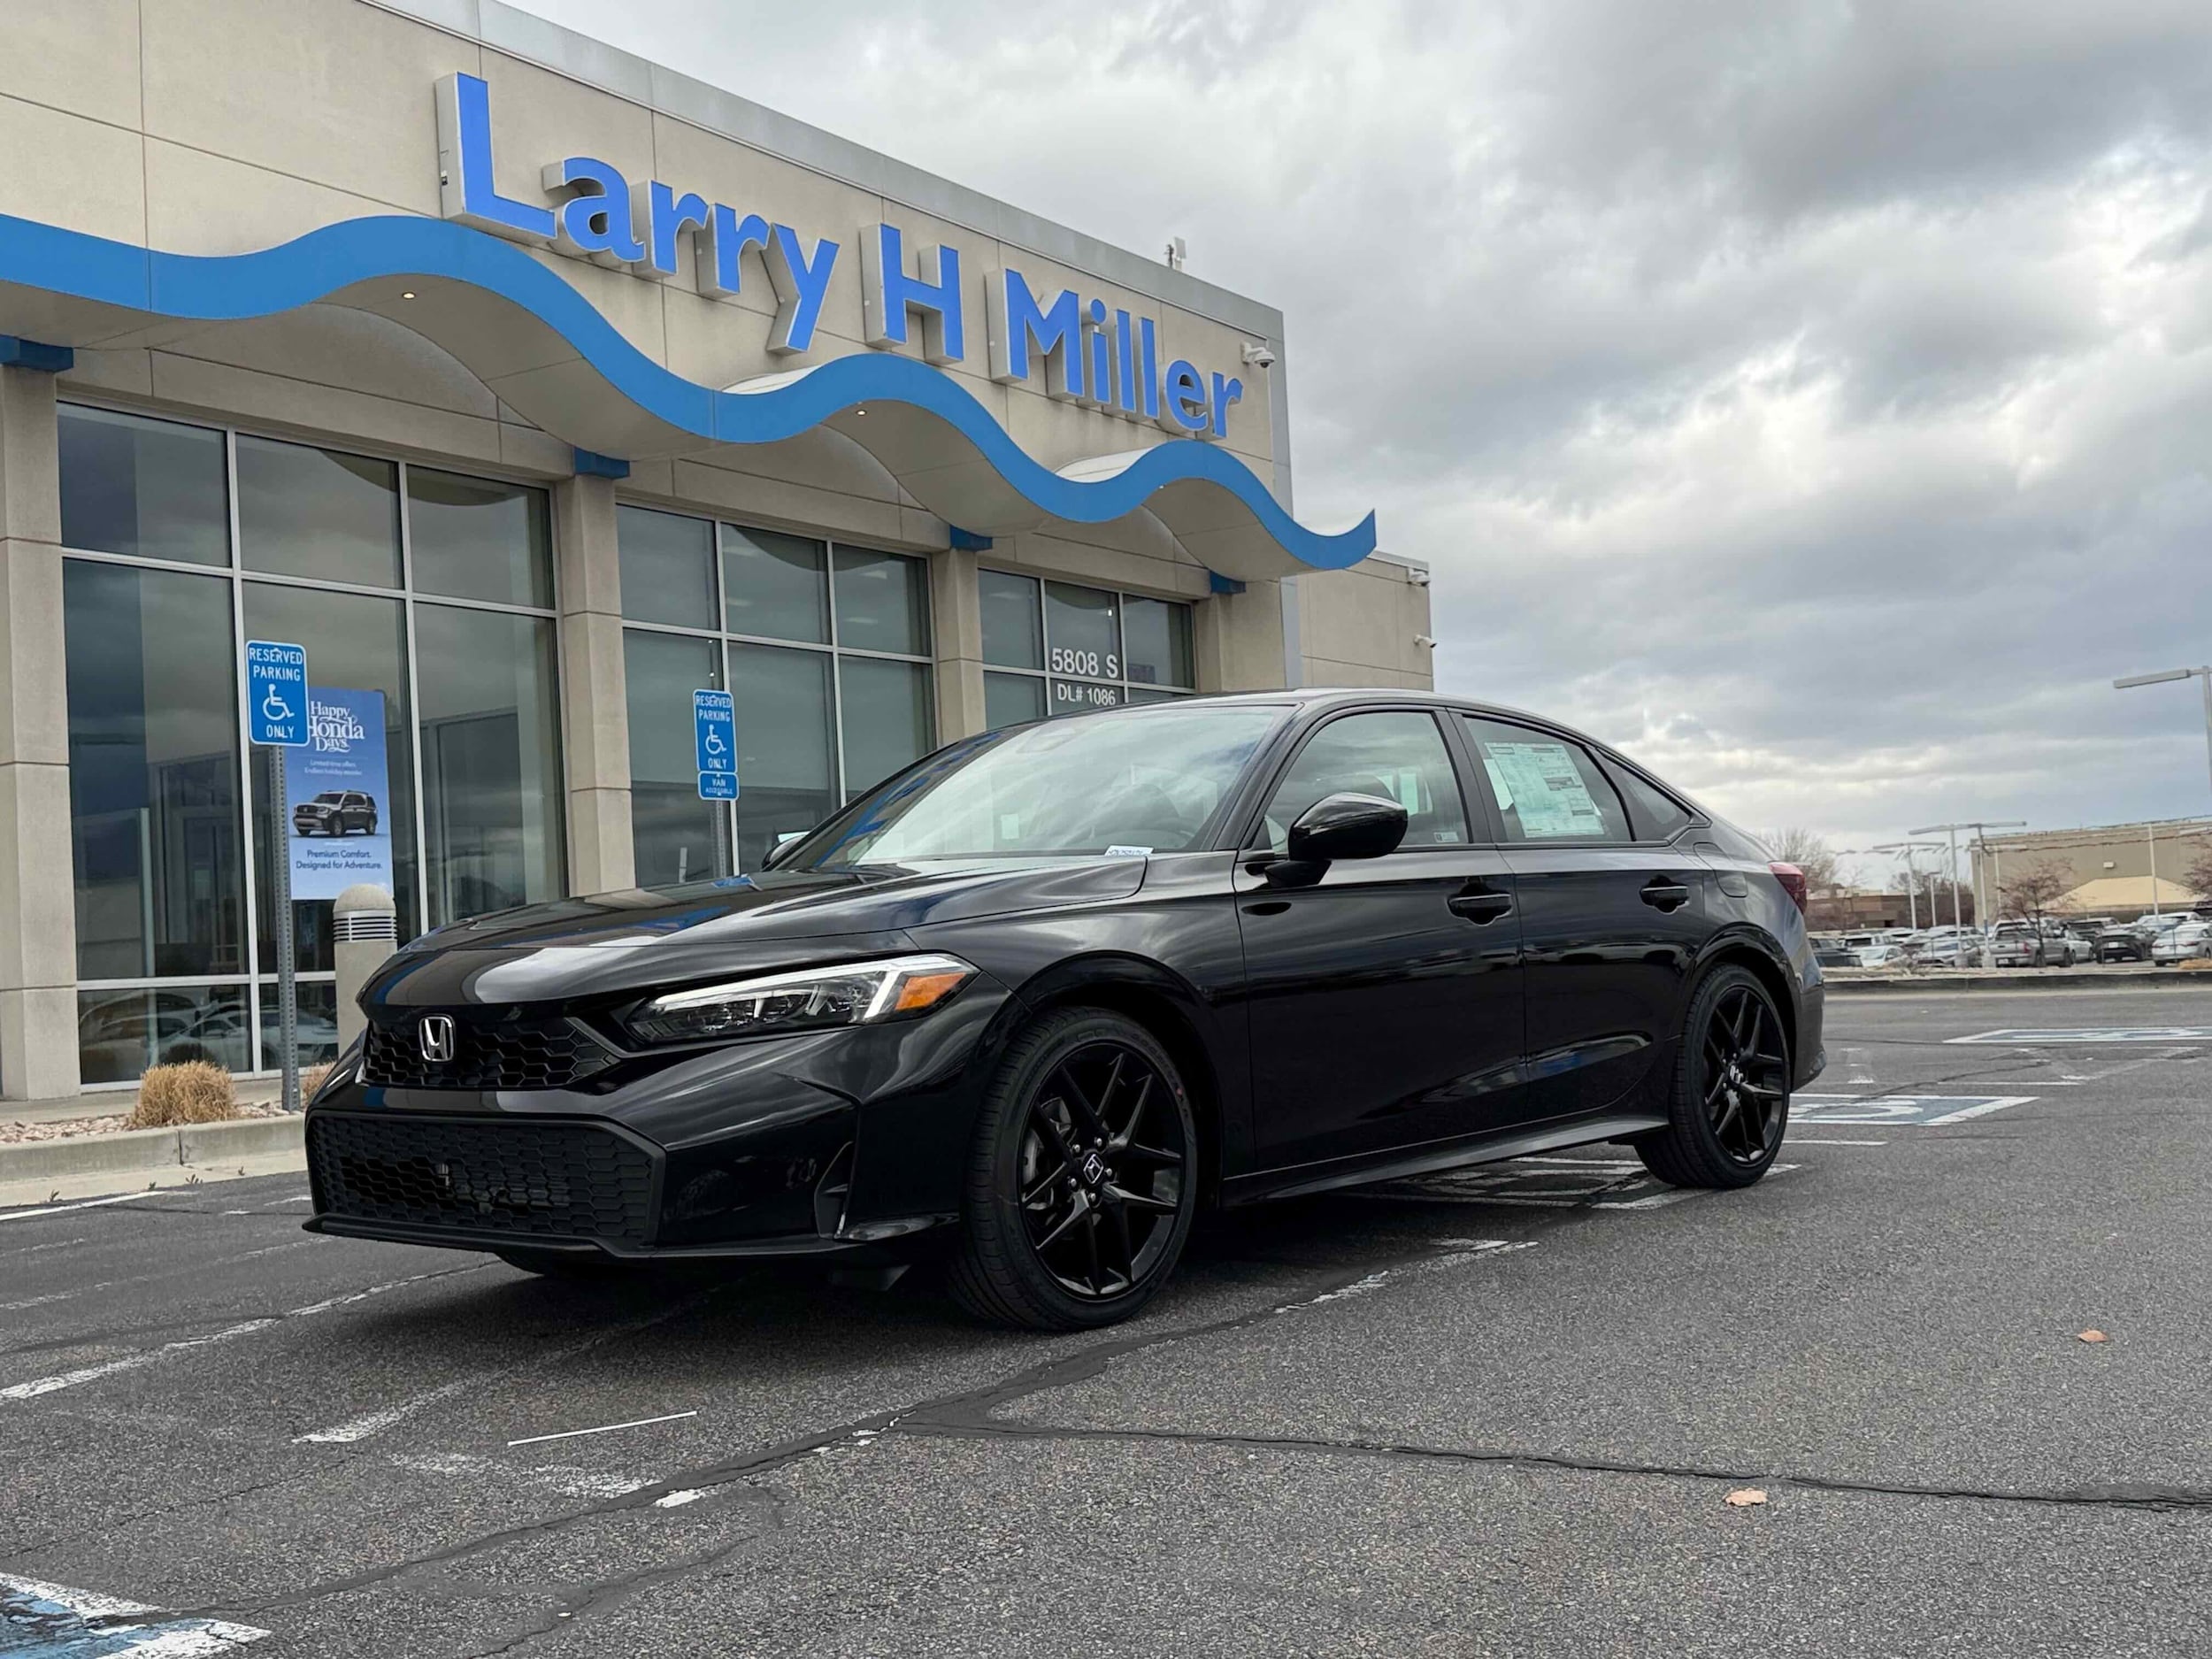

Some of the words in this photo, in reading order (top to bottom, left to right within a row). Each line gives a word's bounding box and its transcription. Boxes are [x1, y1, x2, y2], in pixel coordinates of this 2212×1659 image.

[455, 73, 839, 353] Larry
[879, 223, 964, 362] H
[1005, 269, 1243, 438] Miller
[249, 647, 303, 664] RESERVED
[1052, 648, 1099, 676] 5808
[1106, 654, 1118, 679] S
[253, 664, 301, 681] PARKING
[695, 695, 732, 709] RESERVED
[1057, 683, 1083, 702] DL#
[1087, 687, 1116, 705] 1086
[311, 701, 350, 719] Happy
[698, 709, 731, 722] PARKING
[265, 724, 295, 739] ONLY
[708, 757, 727, 770] ONLY
[711, 778, 726, 787] VAN
[296, 860, 331, 871] Designed
[344, 861, 383, 870] Adventure.
